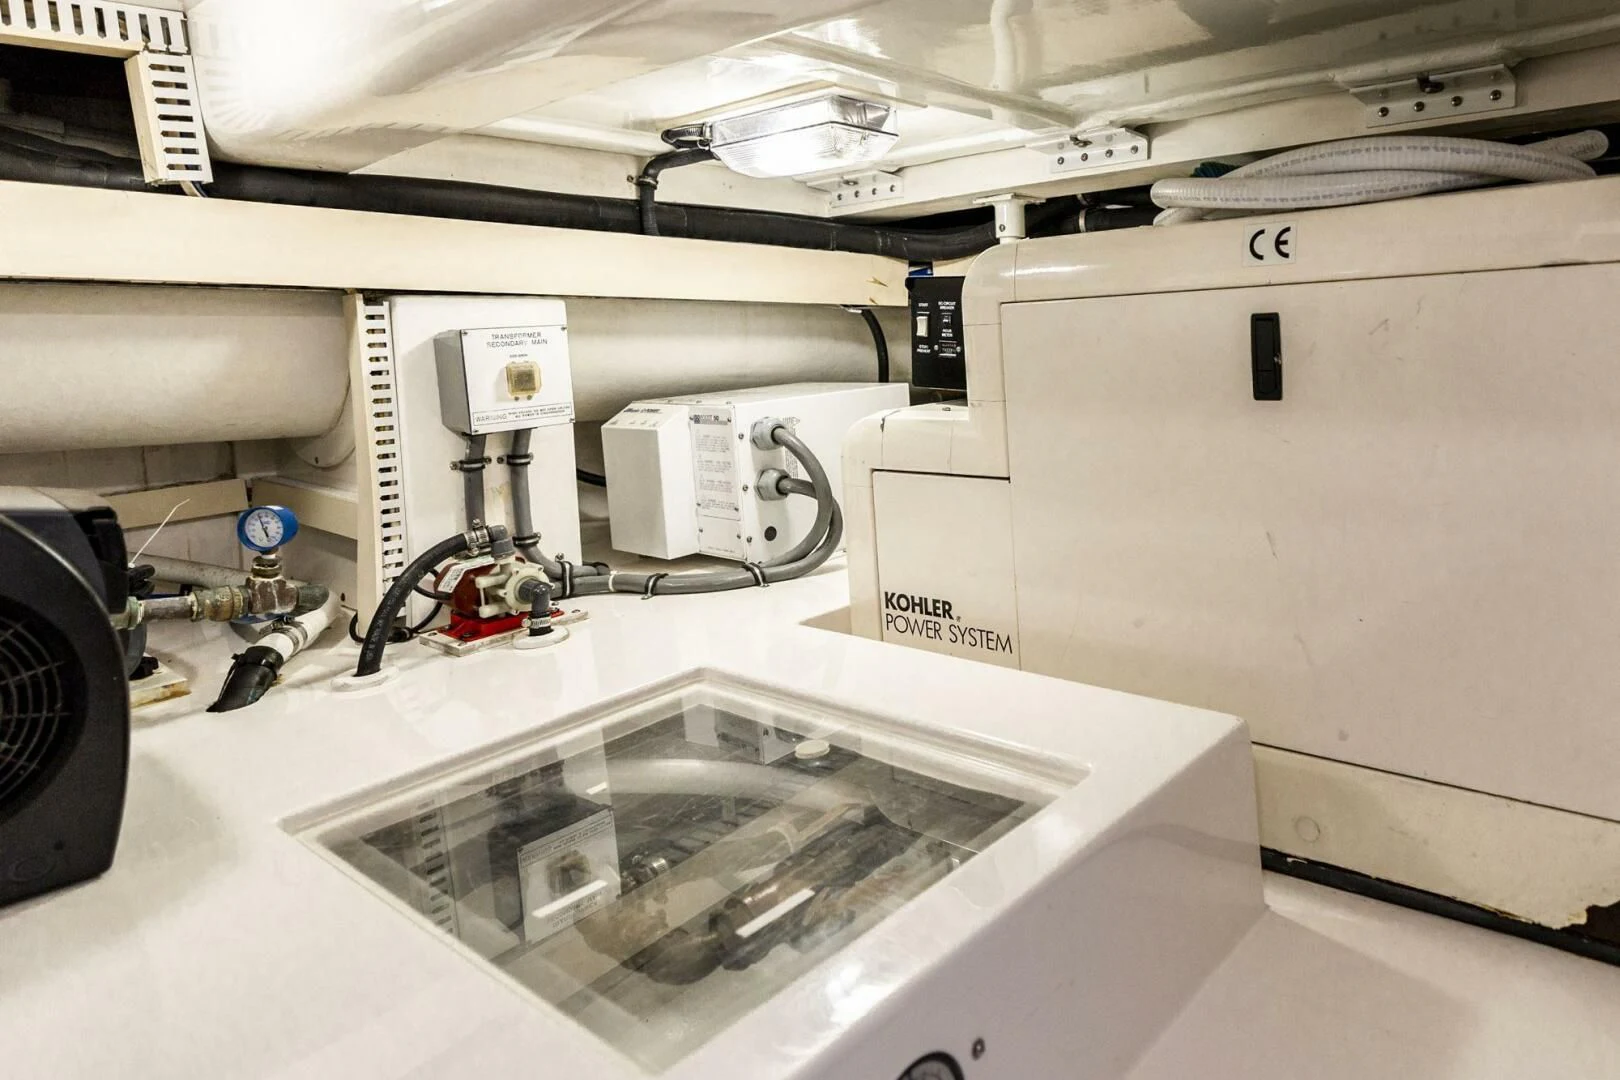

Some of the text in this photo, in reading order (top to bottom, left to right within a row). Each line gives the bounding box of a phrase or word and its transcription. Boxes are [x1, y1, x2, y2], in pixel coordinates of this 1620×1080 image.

[1249, 226, 1291, 260] CE
[486, 340, 528, 348] SECONDARY
[491, 332, 542, 340] TRANSFORMER
[475, 413, 507, 423] WARNING
[884, 591, 954, 620] KOHLER
[886, 613, 1014, 654] POWER SYSTEM
